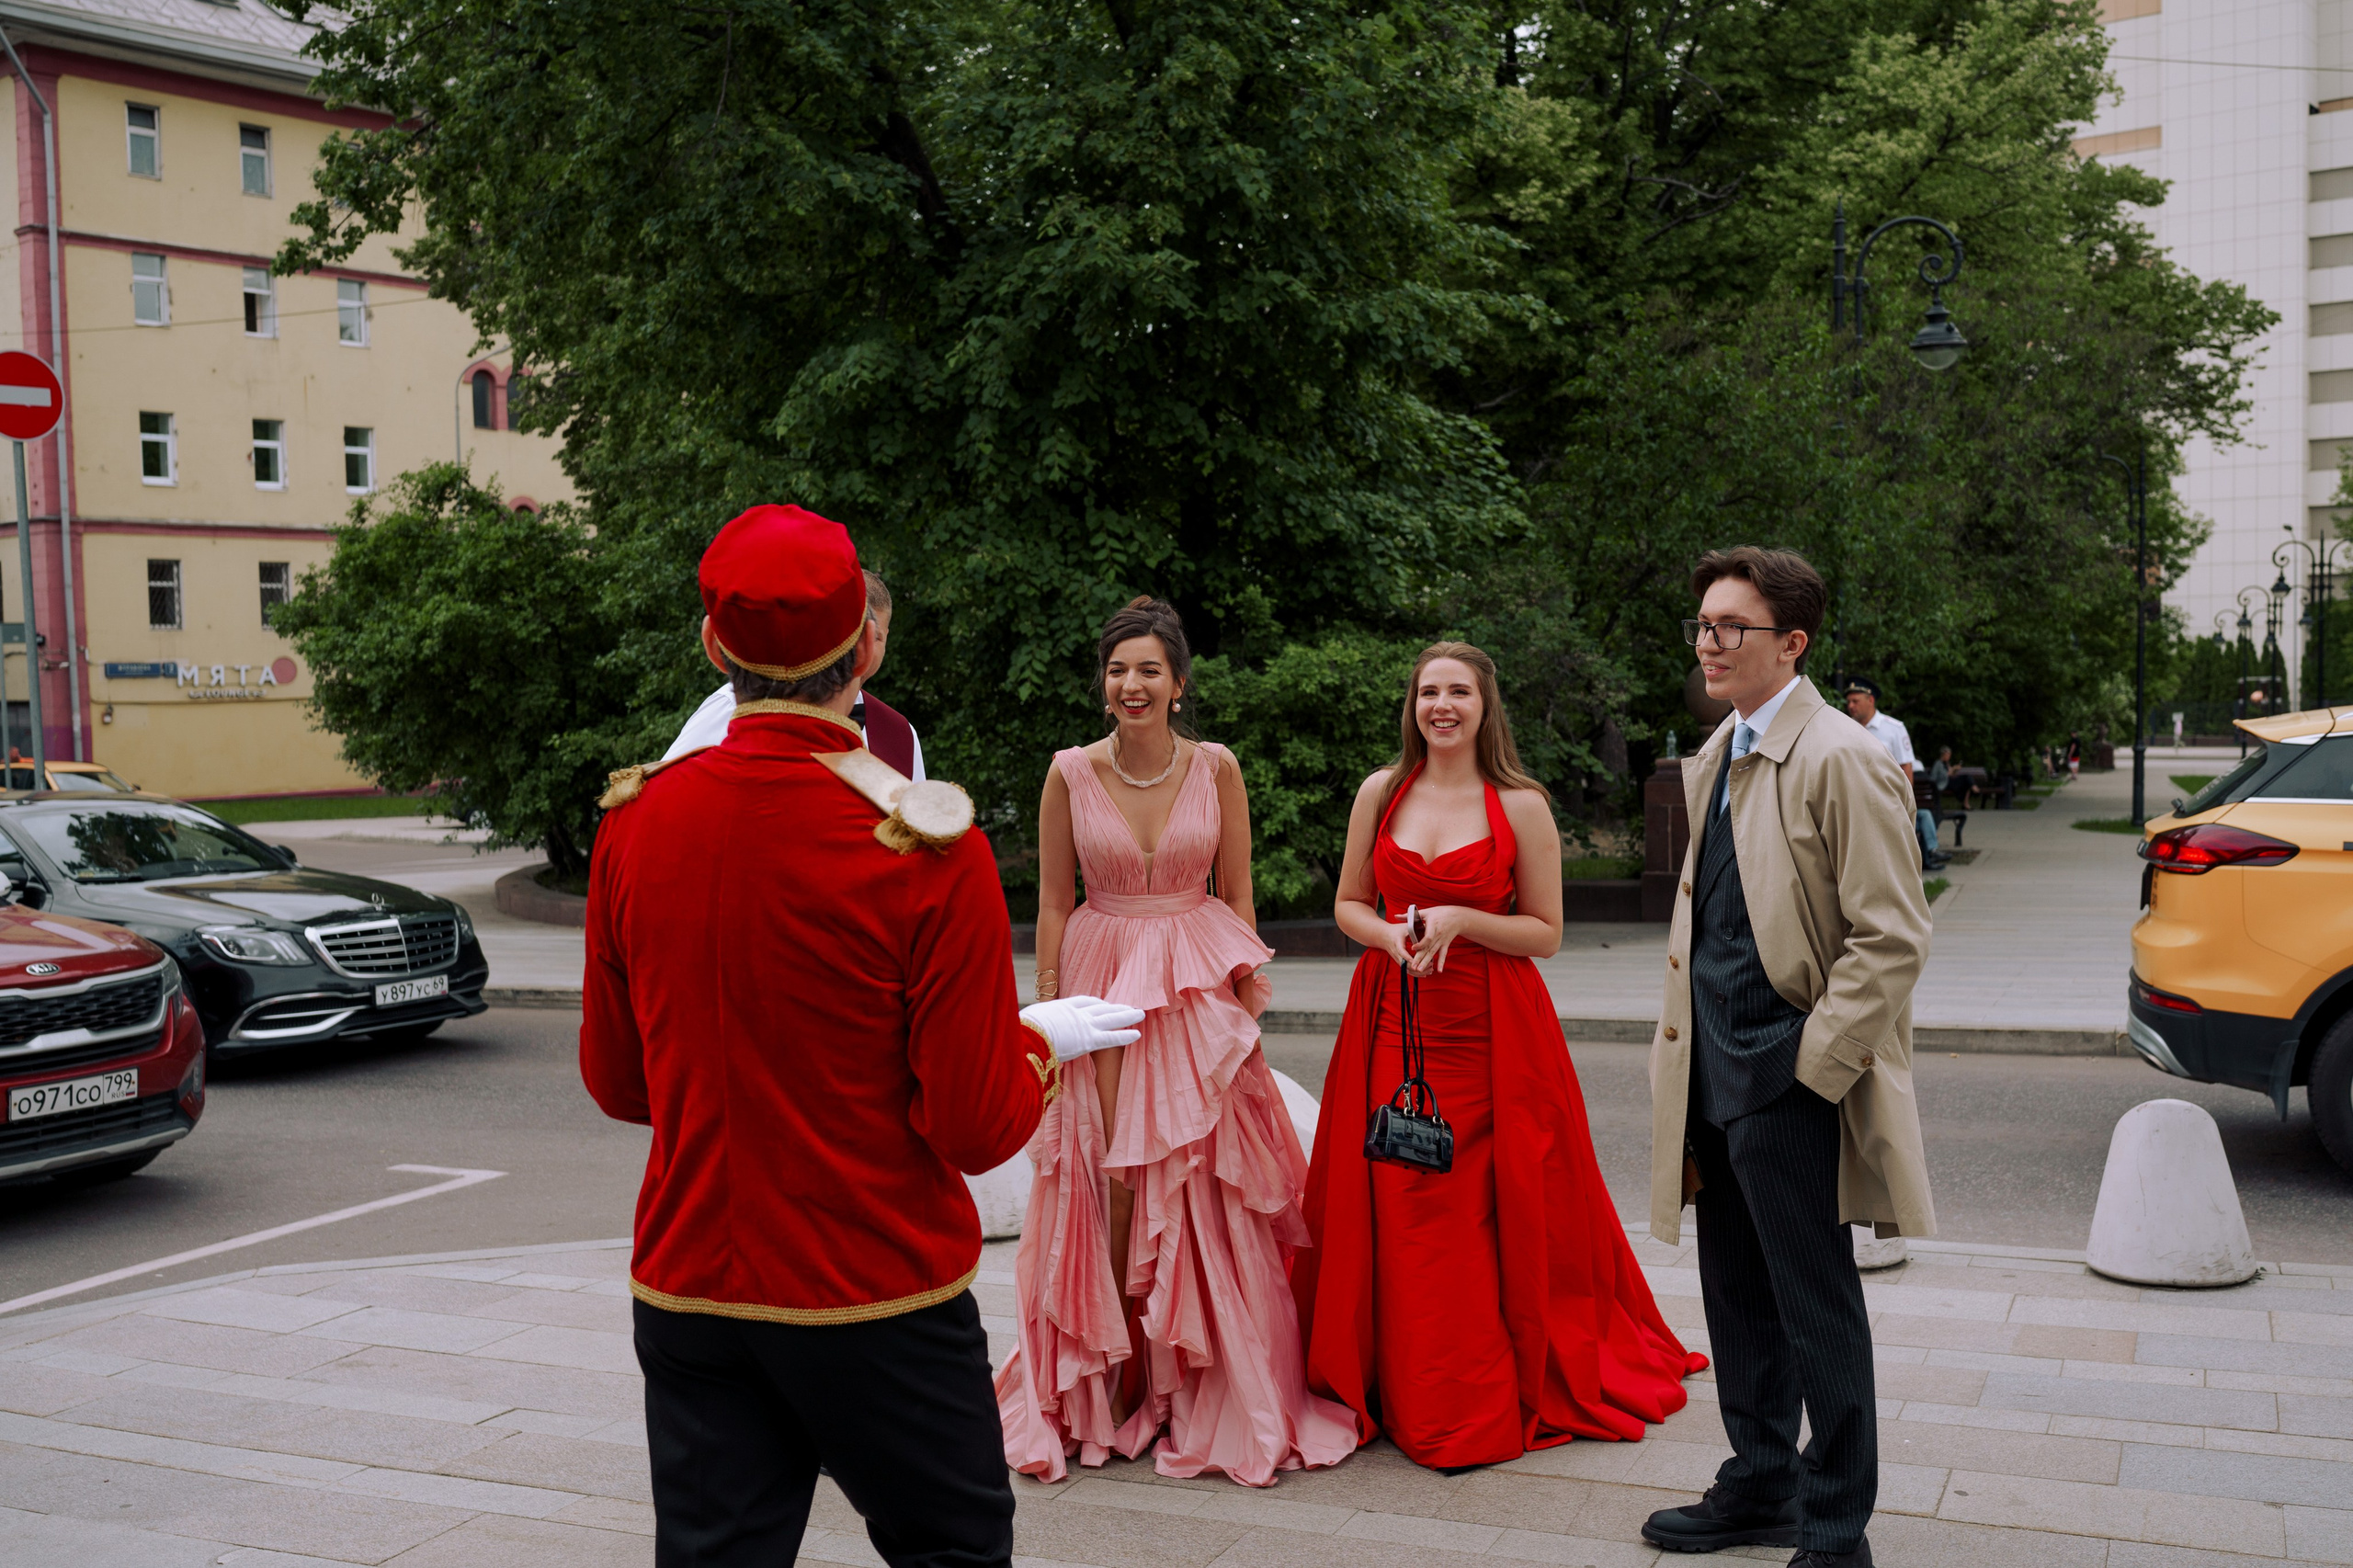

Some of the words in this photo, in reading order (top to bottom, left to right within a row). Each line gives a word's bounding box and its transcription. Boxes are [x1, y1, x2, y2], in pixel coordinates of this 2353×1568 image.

[177, 665, 277, 687] МЯТА
[205, 687, 249, 699] LOUNGE
[29, 963, 58, 973] KIA
[105, 1073, 132, 1093] 799
[111, 1091, 125, 1099] RUS
